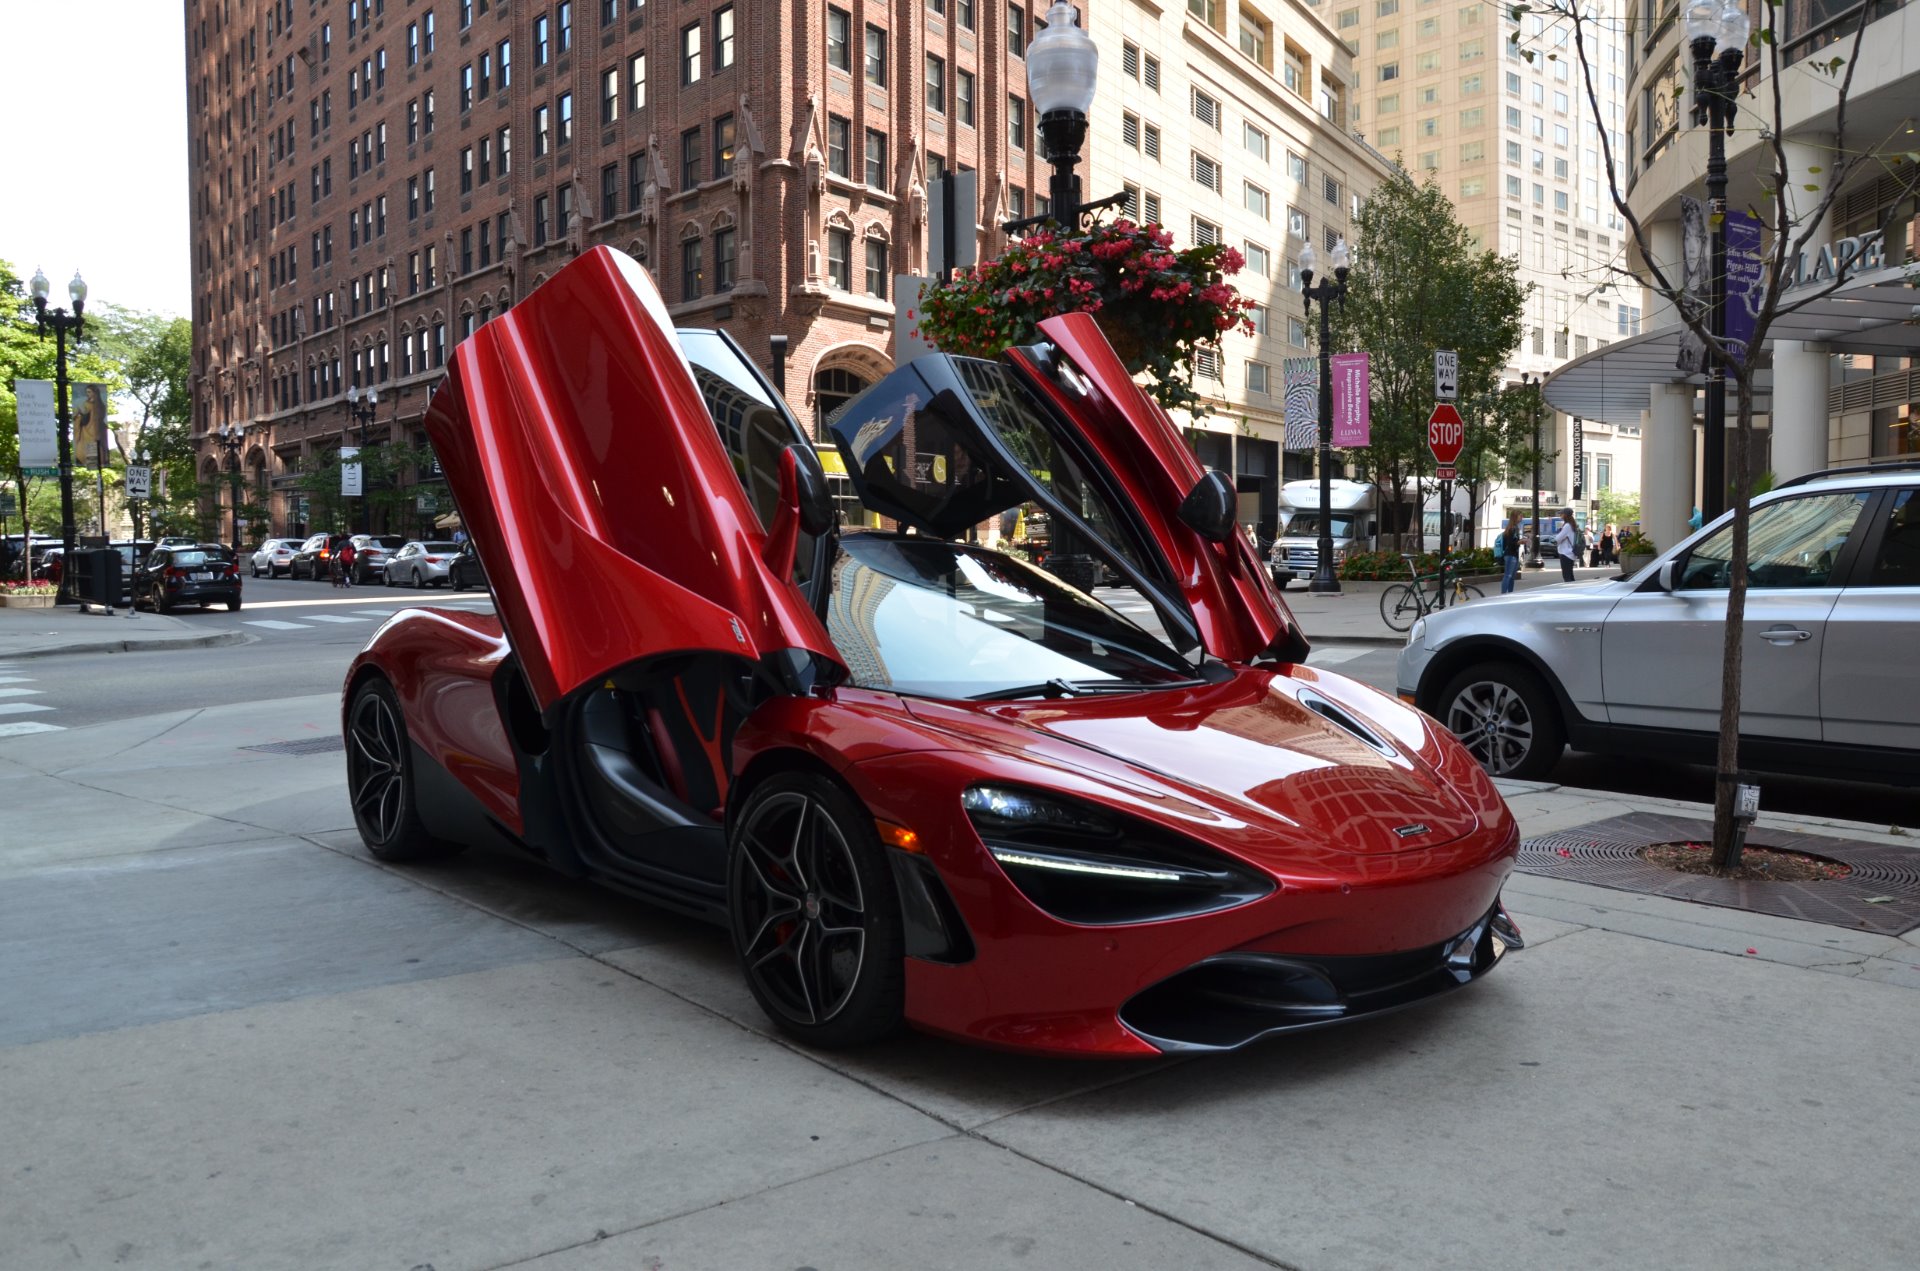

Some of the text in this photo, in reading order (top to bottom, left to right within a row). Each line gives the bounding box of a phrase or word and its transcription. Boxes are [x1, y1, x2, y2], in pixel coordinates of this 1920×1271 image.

[1782, 229, 1886, 290] LARE
[1438, 355, 1455, 367] ONE
[1438, 369, 1455, 380] WAY
[1431, 422, 1461, 445] STOP
[1573, 422, 1582, 487] NORDSTROM rack
[30, 467, 50, 477] RUSH
[129, 469, 147, 477] ONE
